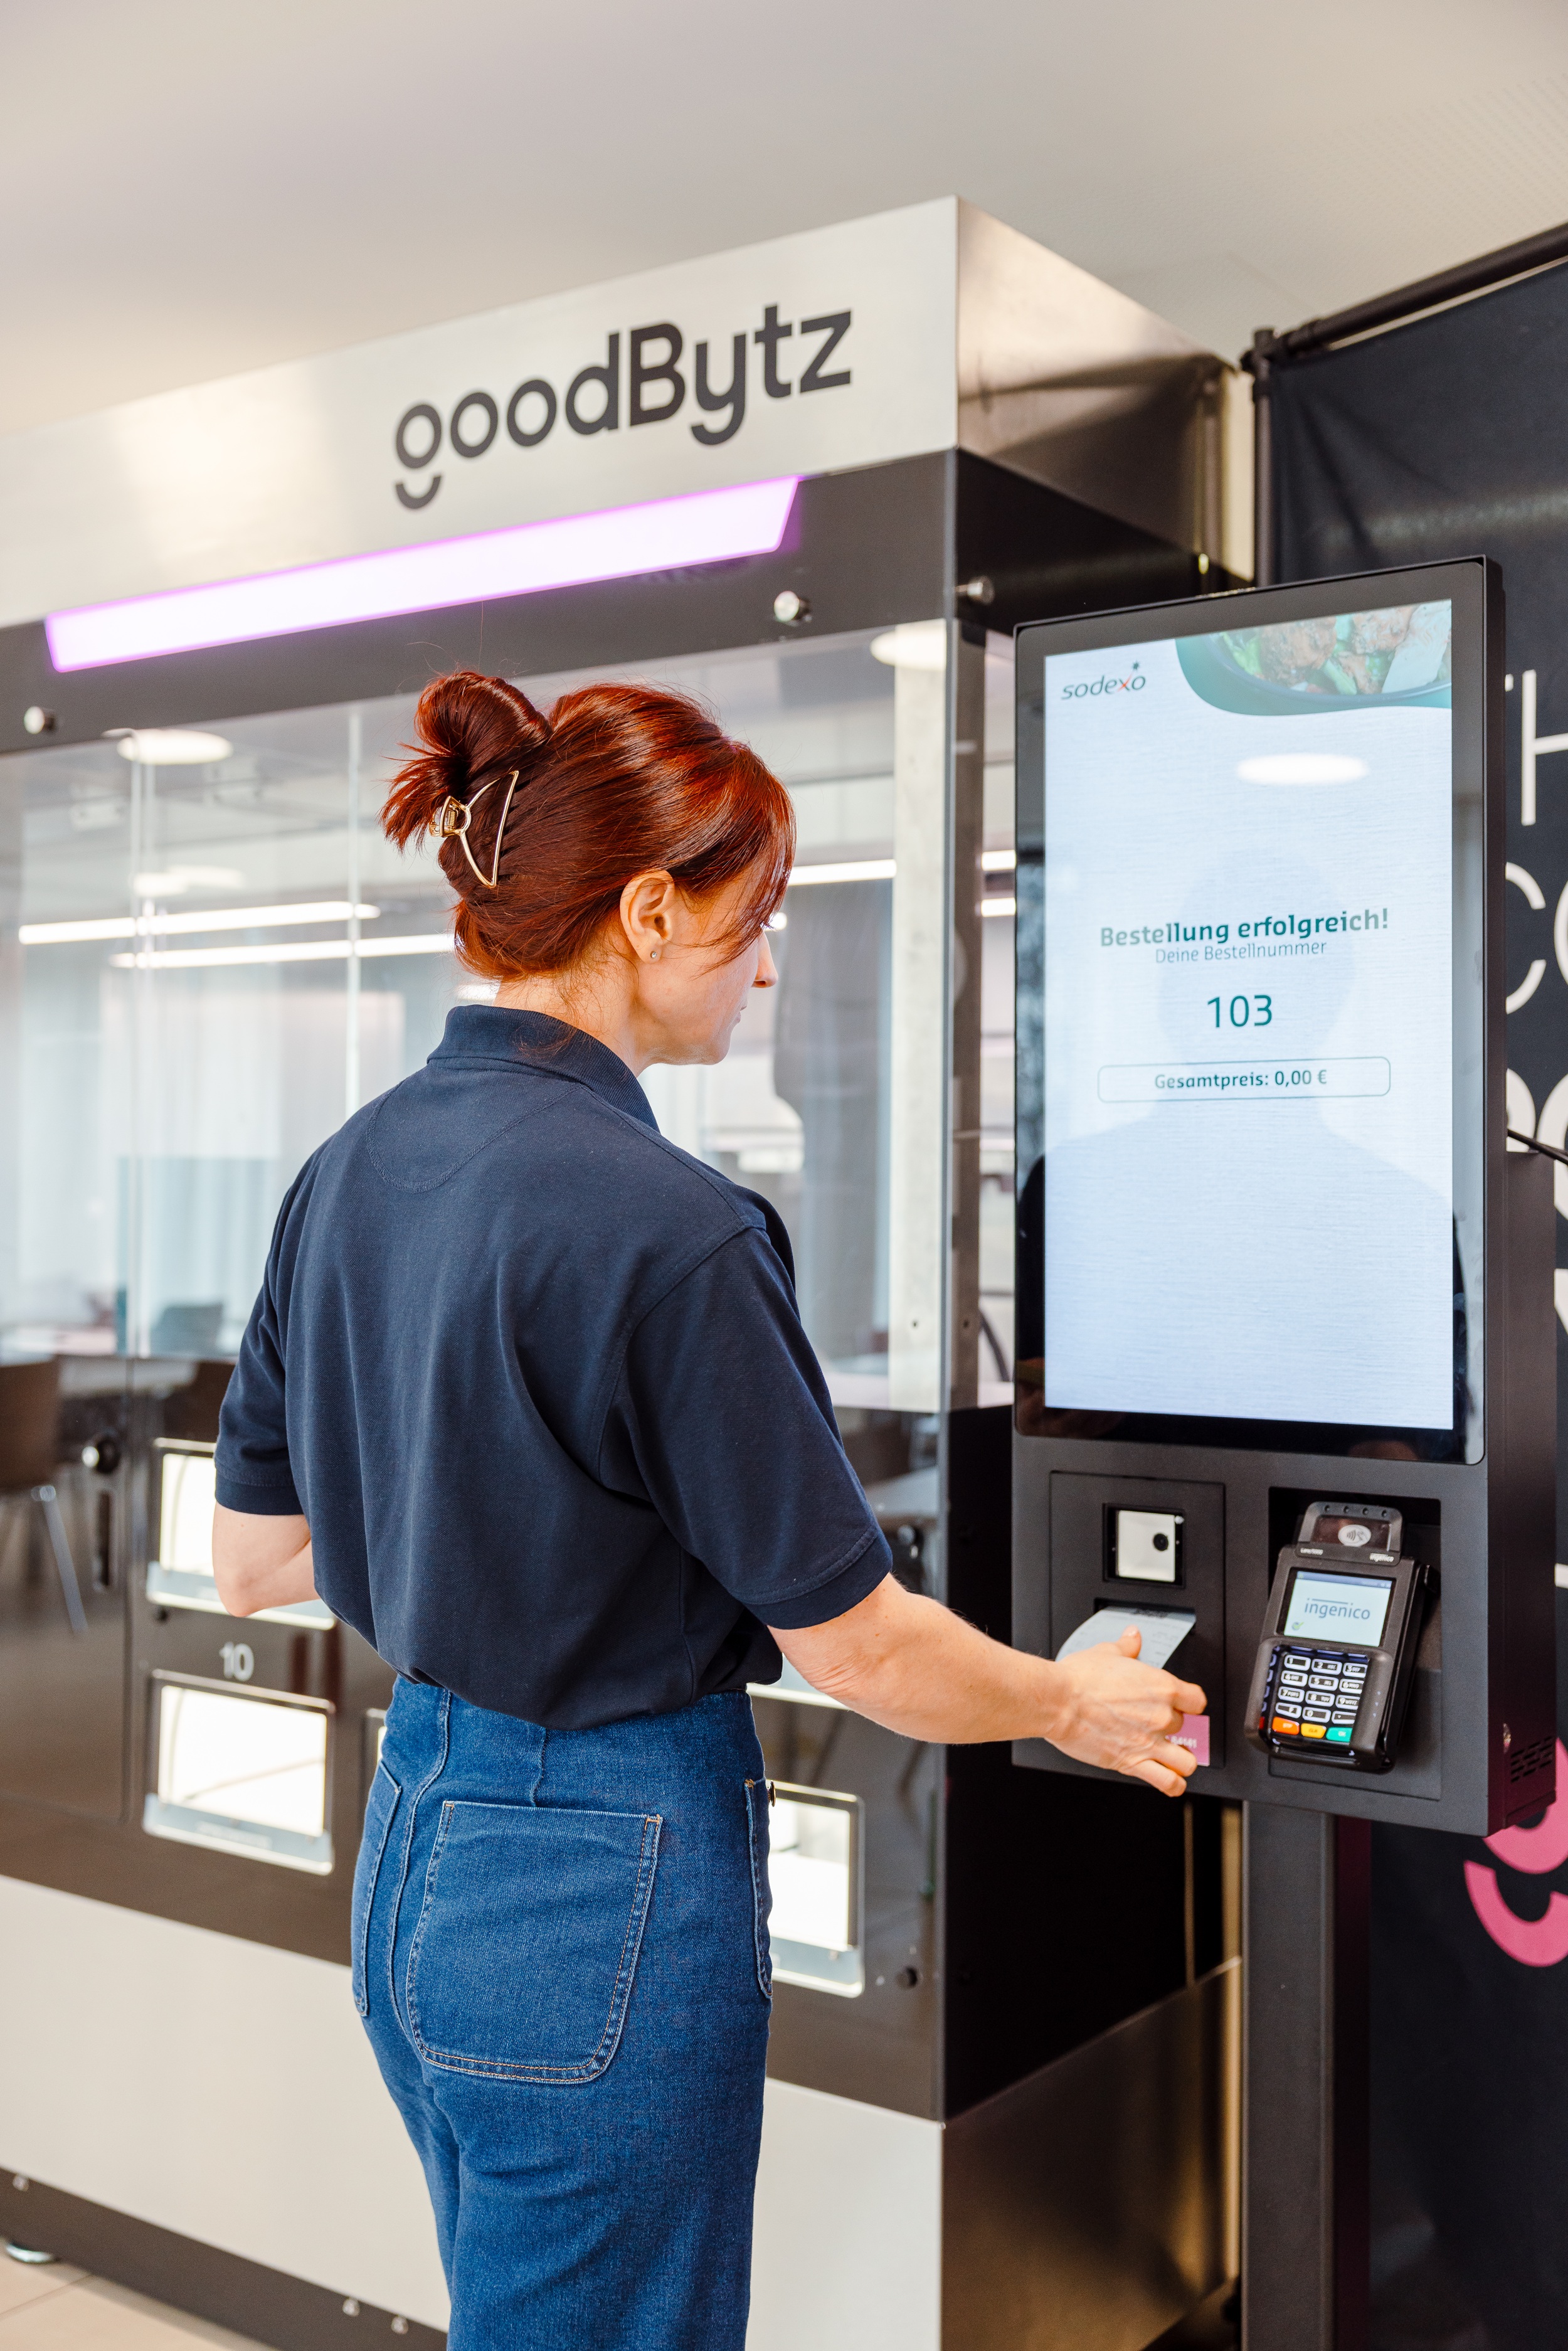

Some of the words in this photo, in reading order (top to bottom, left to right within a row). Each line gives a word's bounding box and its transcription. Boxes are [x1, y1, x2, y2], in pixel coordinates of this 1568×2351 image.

[395, 304, 852, 510] goodBytz
[1061, 670, 1146, 700] sodexo
[1101, 922, 1229, 947] Bestellung
[1237, 908, 1388, 939] erfolgreich!
[1155, 947, 1199, 963] Deine
[1204, 942, 1327, 960] Bestellnummer
[1207, 994, 1273, 1028] 103
[1155, 1071, 1269, 1090] Gesamtpreis:
[1274, 1069, 1312, 1087] 0,00
[1317, 1069, 1327, 1085] €
[1304, 1598, 1370, 1620] ingenico
[219, 1641, 255, 1682] 10
